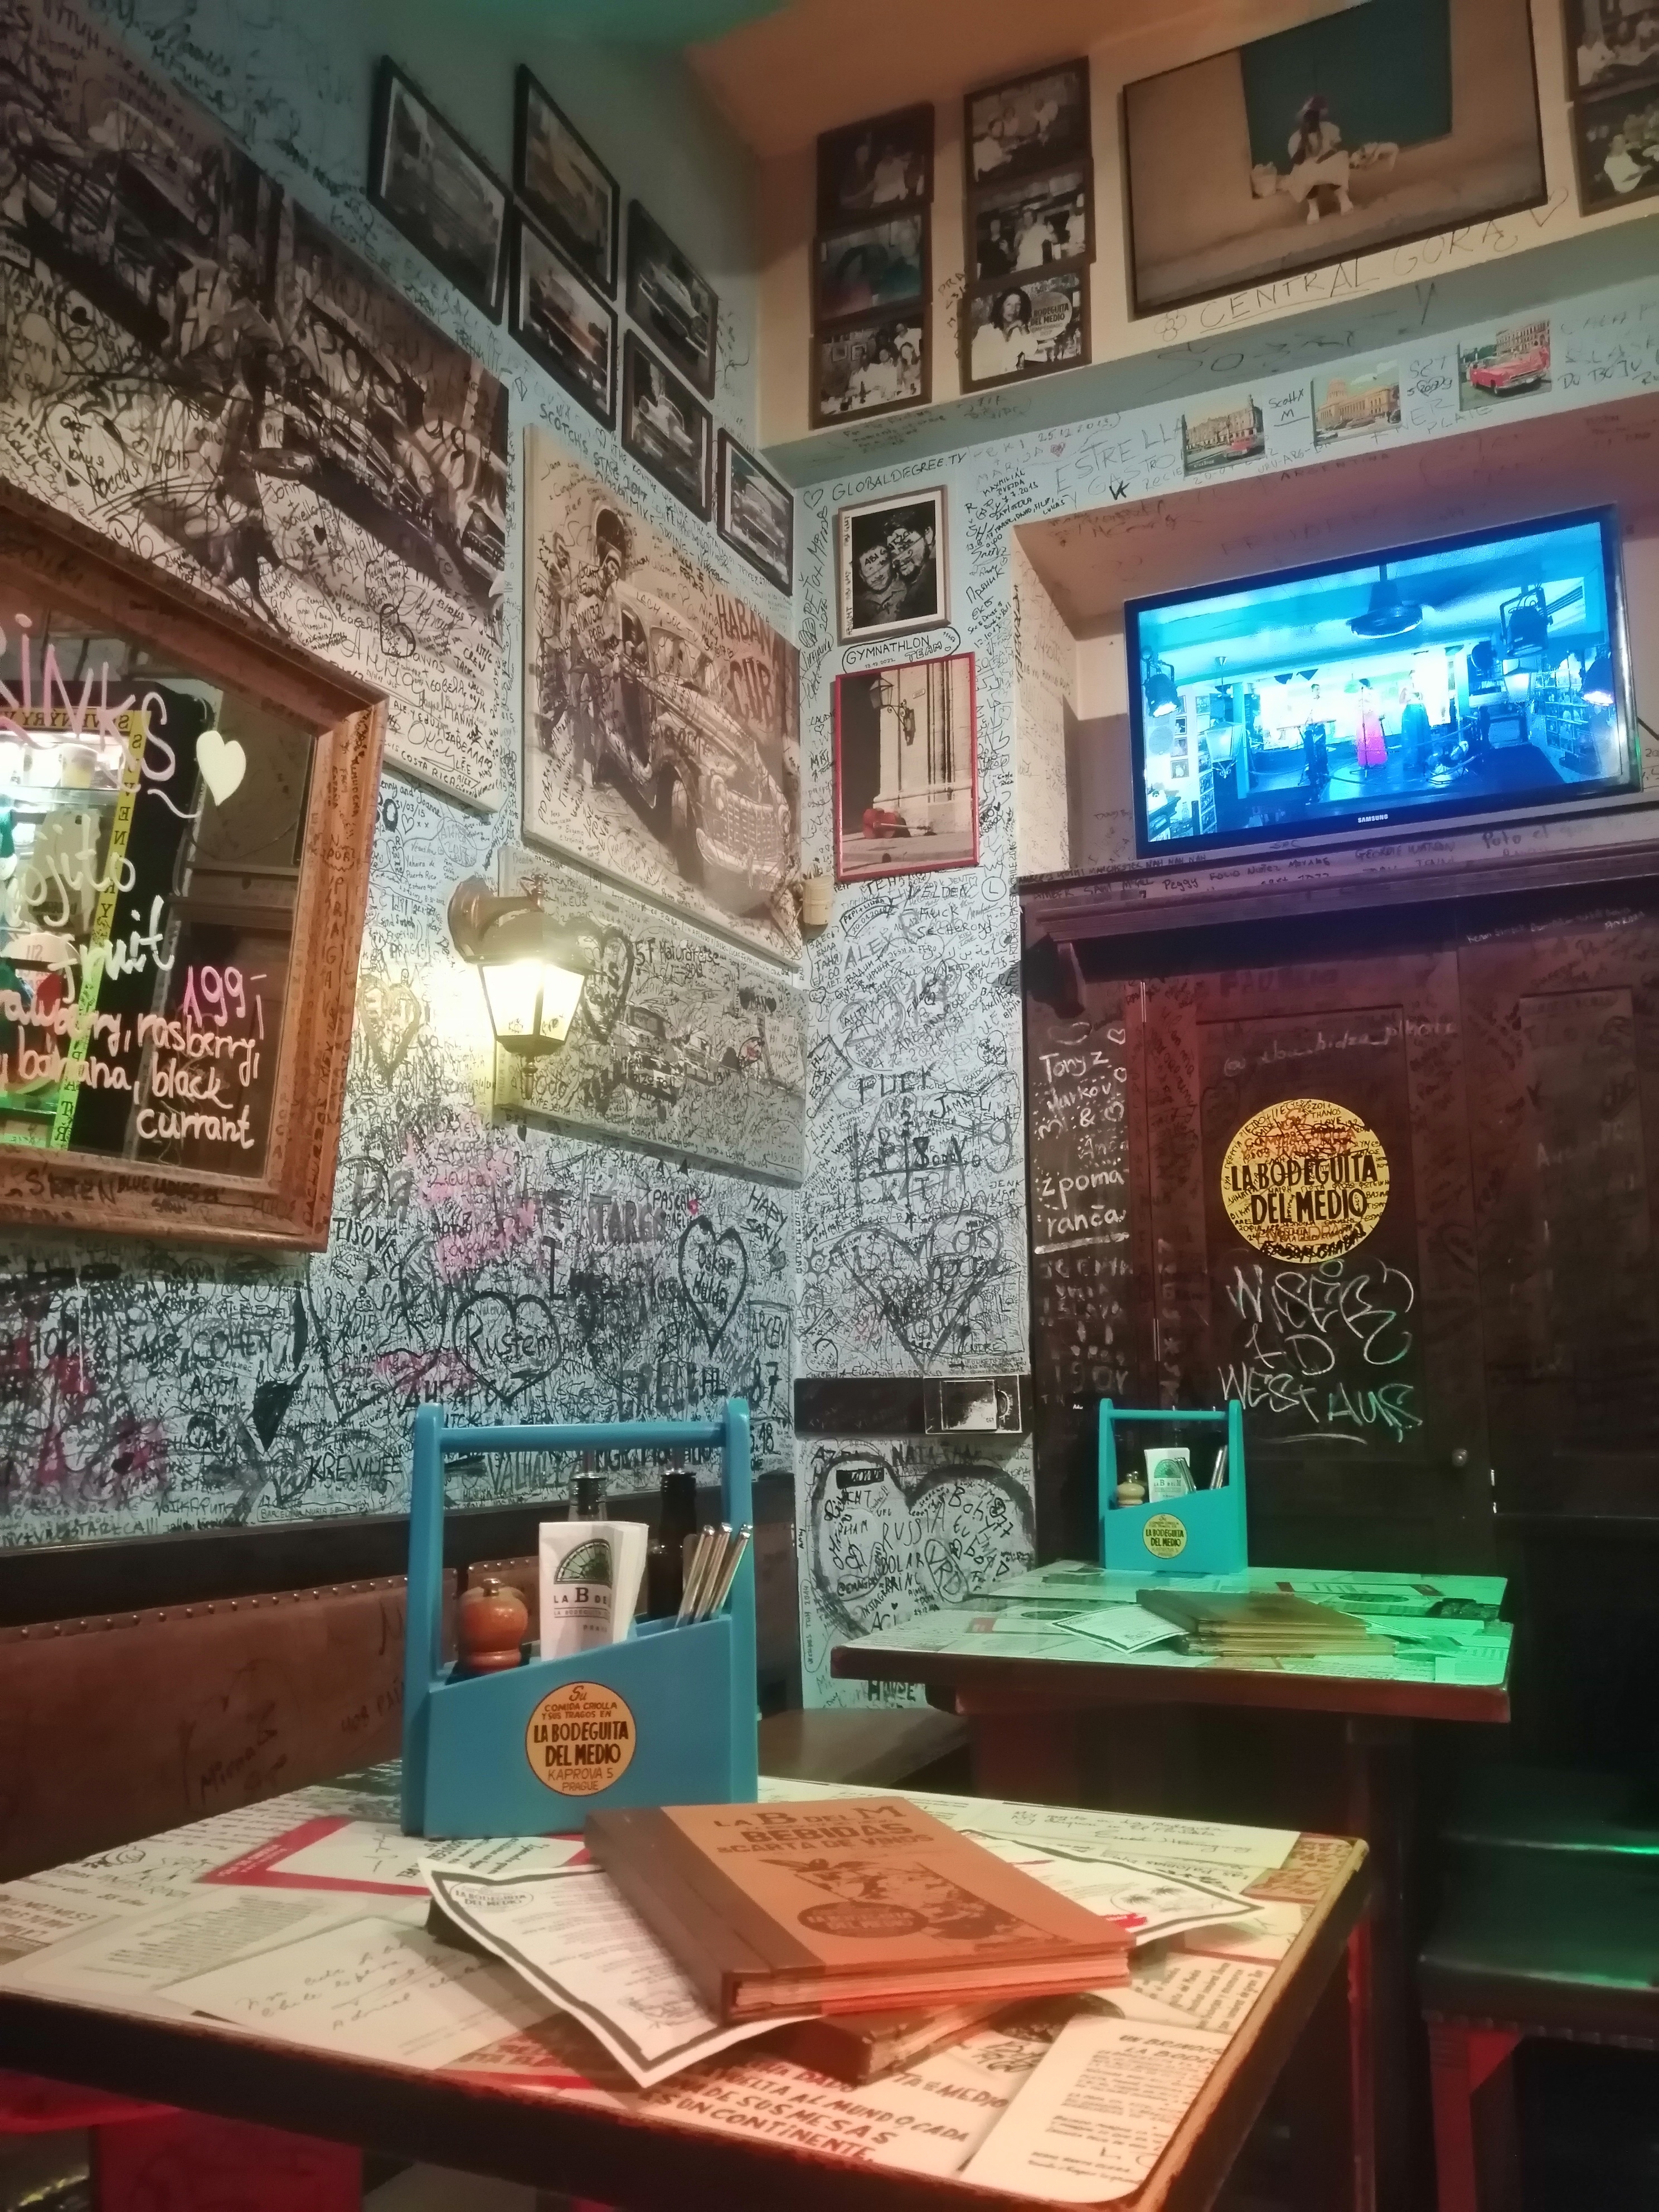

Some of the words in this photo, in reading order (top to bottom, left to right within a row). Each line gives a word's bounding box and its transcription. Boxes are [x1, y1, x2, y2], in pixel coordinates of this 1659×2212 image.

[846, 635, 930, 665] GYMNATHLON
[904, 642, 943, 662] TEAM
[401, 751, 428, 769] COSTA
[379, 782, 398, 799] enny
[1358, 814, 1388, 823] SAMSUNG
[1163, 876, 1199, 891] Peggy
[1039, 1052, 1087, 1084] Tony
[151, 1051, 234, 1109] black
[136, 1104, 255, 1149] currant
[1231, 1164, 1255, 1192] LA
[1257, 1154, 1379, 1191] BODEGUITA
[1250, 1192, 1292, 1226] DEL
[1295, 1188, 1368, 1223] MEDIO
[1145, 1529, 1152, 1537] LA
[1152, 1529, 1185, 1537] BODEGUITA
[1150, 1537, 1162, 1546] DEL
[1162, 1537, 1182, 1547] MEDIO
[553, 1594, 569, 1604] LA
[575, 1587, 590, 1603] B
[594, 1595, 611, 1605] DE
[568, 1685, 587, 1702] Su
[544, 1702, 581, 1712] COMIDA
[583, 1701, 618, 1710] CRIOLLA
[564, 1710, 596, 1719] TRAGOS
[600, 1710, 612, 1718] EN
[533, 1724, 549, 1744] LA
[551, 1720, 629, 1743] BODEGUITA
[545, 1744, 573, 1768] DEL
[574, 1743, 622, 1766] MEDIO
[547, 1768, 603, 1782] KAPROVA
[606, 1767, 614, 1779] 5
[561, 1781, 599, 1792] PRAGUE
[714, 1819, 753, 1827] LA
[750, 1811, 798, 1826] B
[802, 1814, 857, 1823] DEL
[850, 1804, 908, 1820] M
[740, 1822, 914, 1843] BEBIDAS
[736, 2095, 794, 2116] SUS
[786, 2109, 900, 2146] MESAS
[787, 2093, 827, 2106] AL
[912, 2119, 971, 2145] CADA
